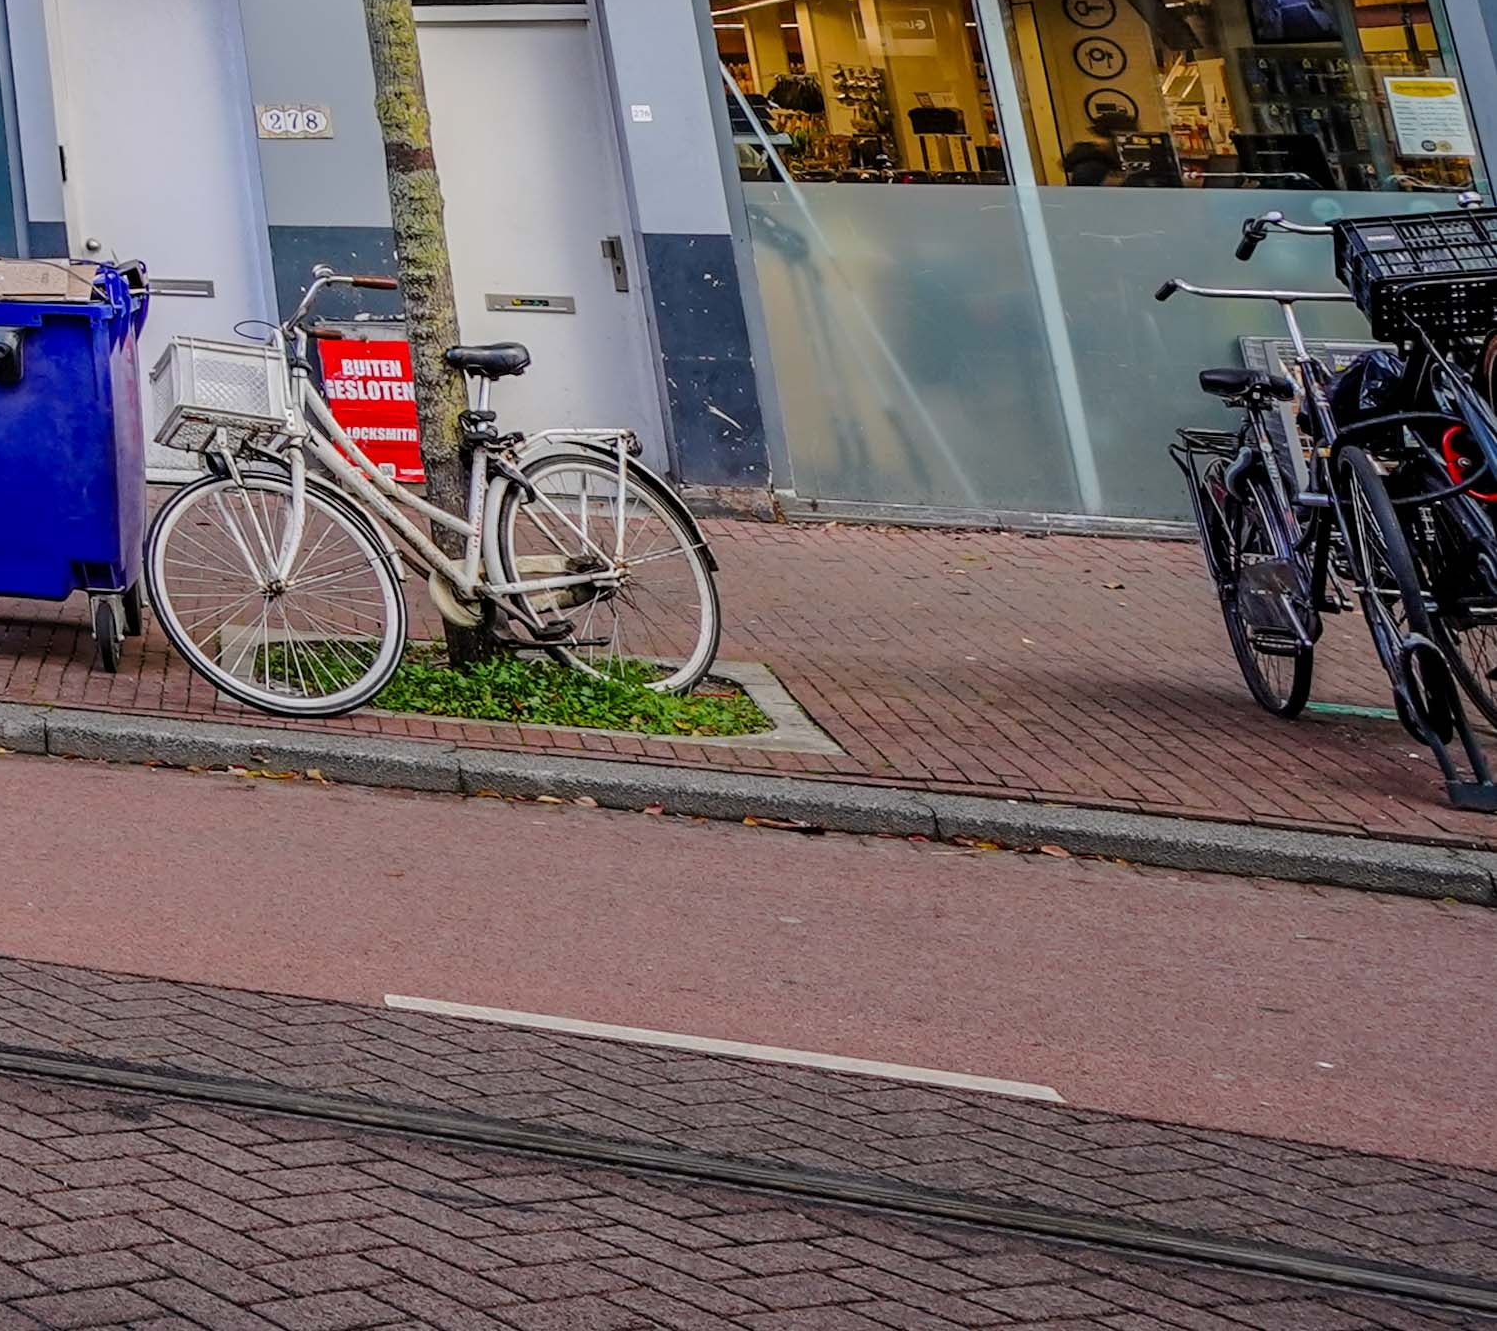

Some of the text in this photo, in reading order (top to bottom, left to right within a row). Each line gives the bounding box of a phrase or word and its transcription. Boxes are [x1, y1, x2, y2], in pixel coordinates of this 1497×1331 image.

[269, 112, 319, 130] 278
[340, 358, 403, 378] BUITEN
[323, 378, 417, 402] GESLOTEN
